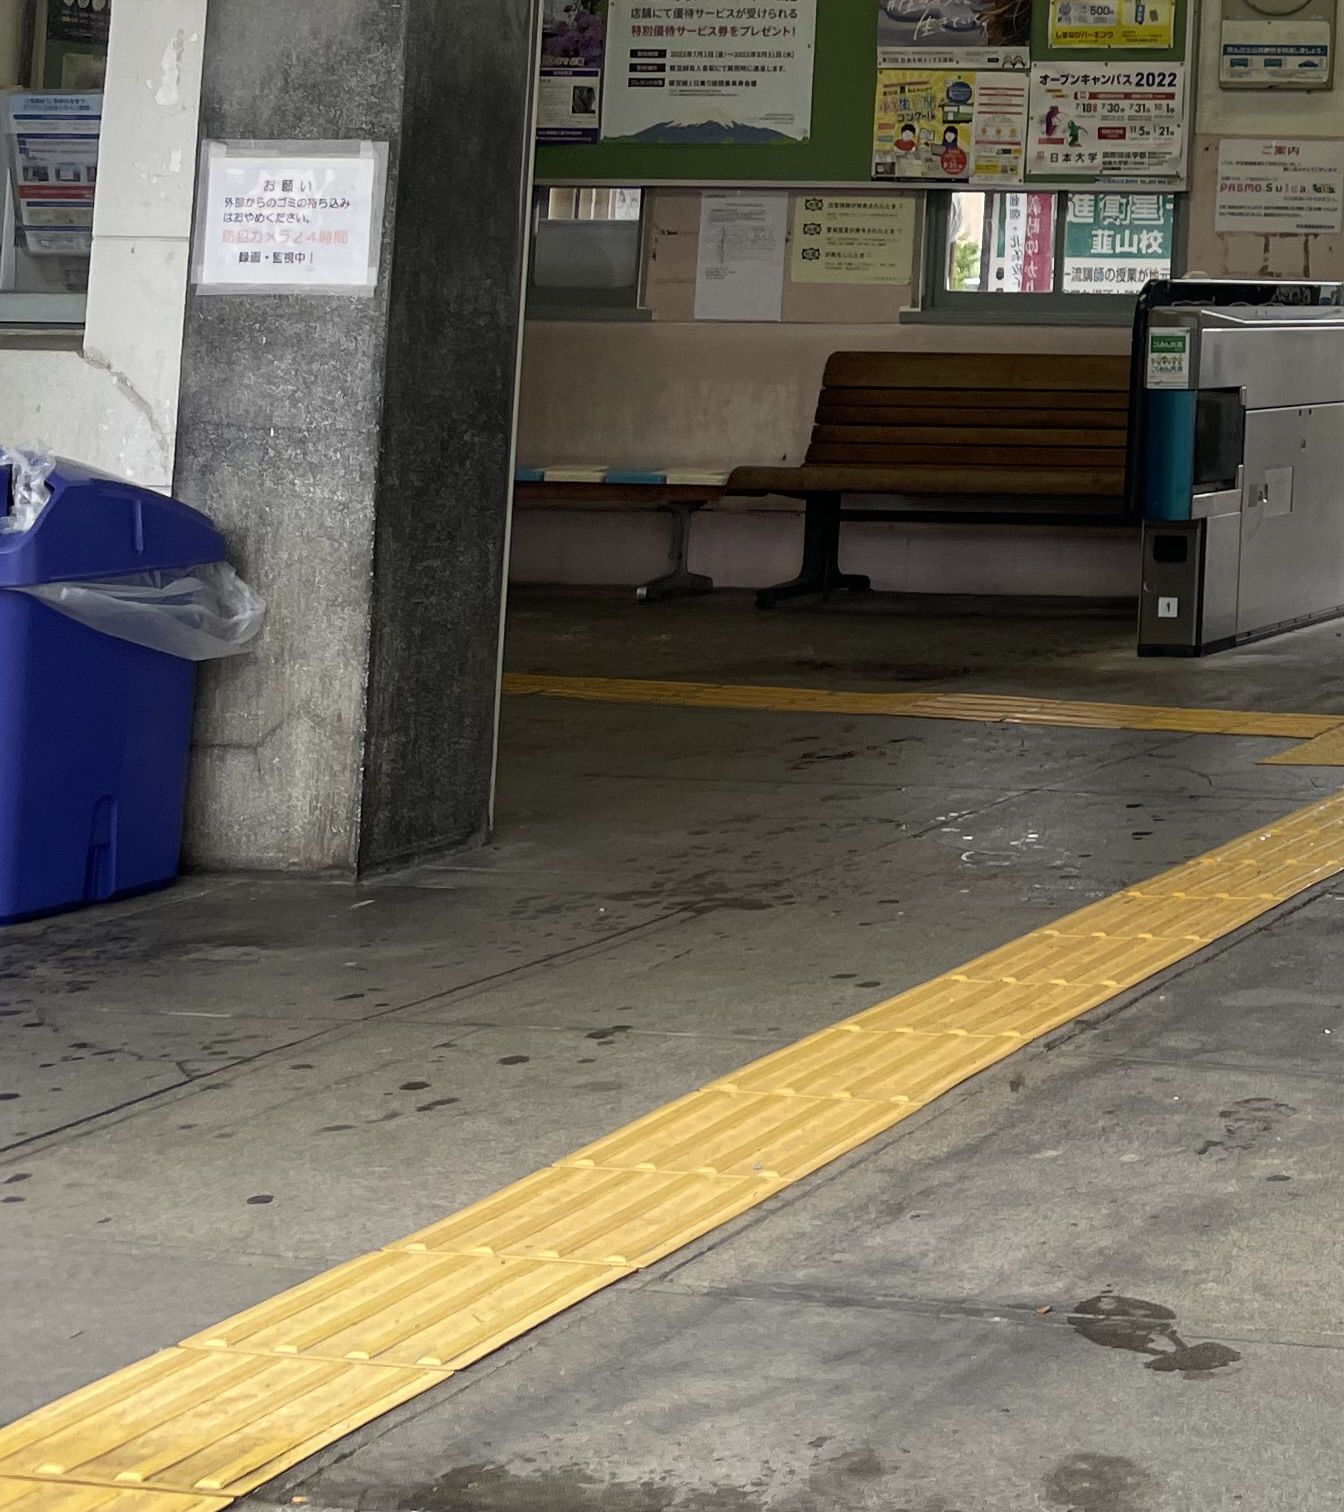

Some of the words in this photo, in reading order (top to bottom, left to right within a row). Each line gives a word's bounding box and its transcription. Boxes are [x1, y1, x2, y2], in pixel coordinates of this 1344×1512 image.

[1039, 73, 1133, 86] オープンキャンパス
[1134, 71, 1178, 87] 2022
[1262, 144, 1300, 157] ご案内
[1050, 152, 1098, 163] 日本大学
[263, 179, 312, 192] お願い
[1219, 182, 1262, 194] PASMO
[224, 196, 351, 209] 外部からのゴミの持ち込み
[223, 212, 311, 224] はおやめください。
[1090, 229, 1163, 255] 韮山校
